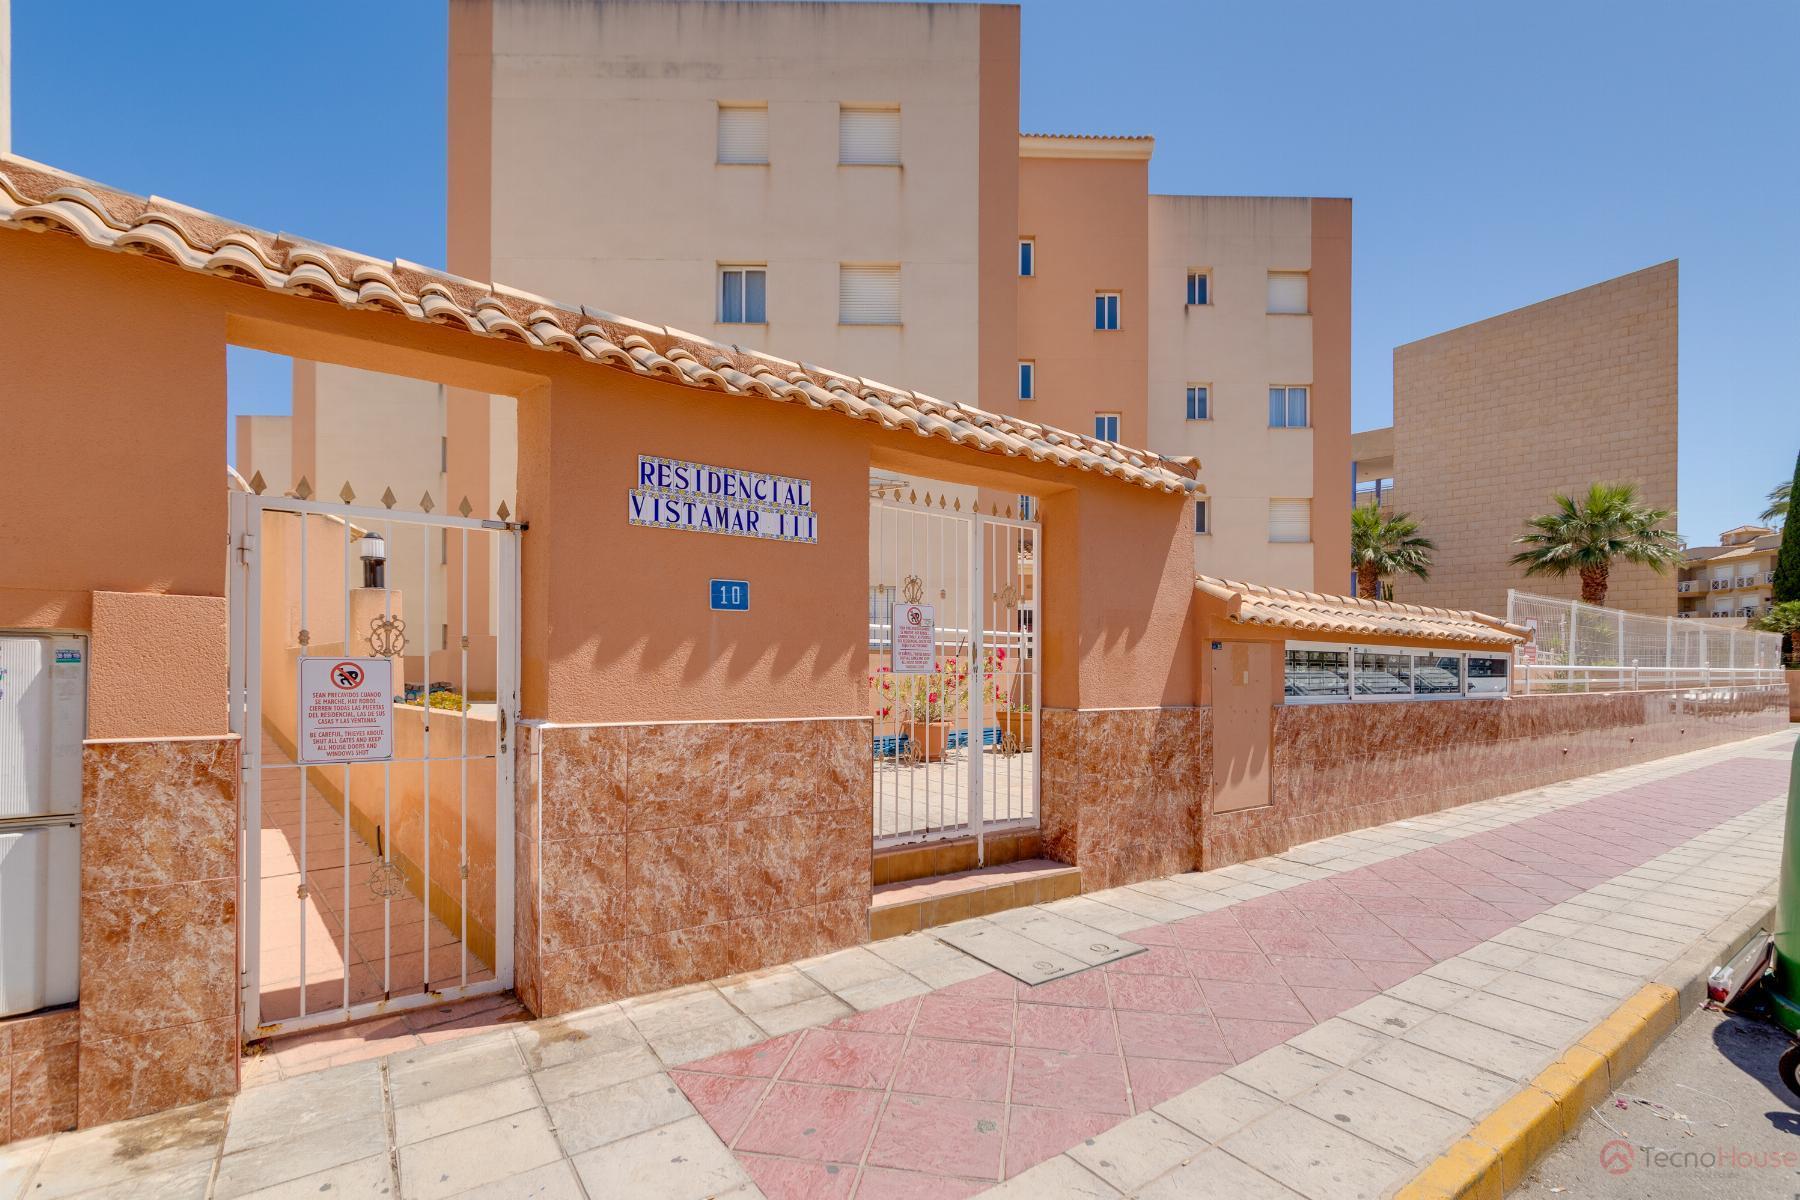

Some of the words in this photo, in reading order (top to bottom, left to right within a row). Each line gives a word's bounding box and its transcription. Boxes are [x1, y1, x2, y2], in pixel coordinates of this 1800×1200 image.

[640, 461, 810, 507] RESIDENCIAL
[631, 495, 760, 532] VISTAMAR
[779, 513, 813, 538] III
[720, 585, 741, 605] 10
